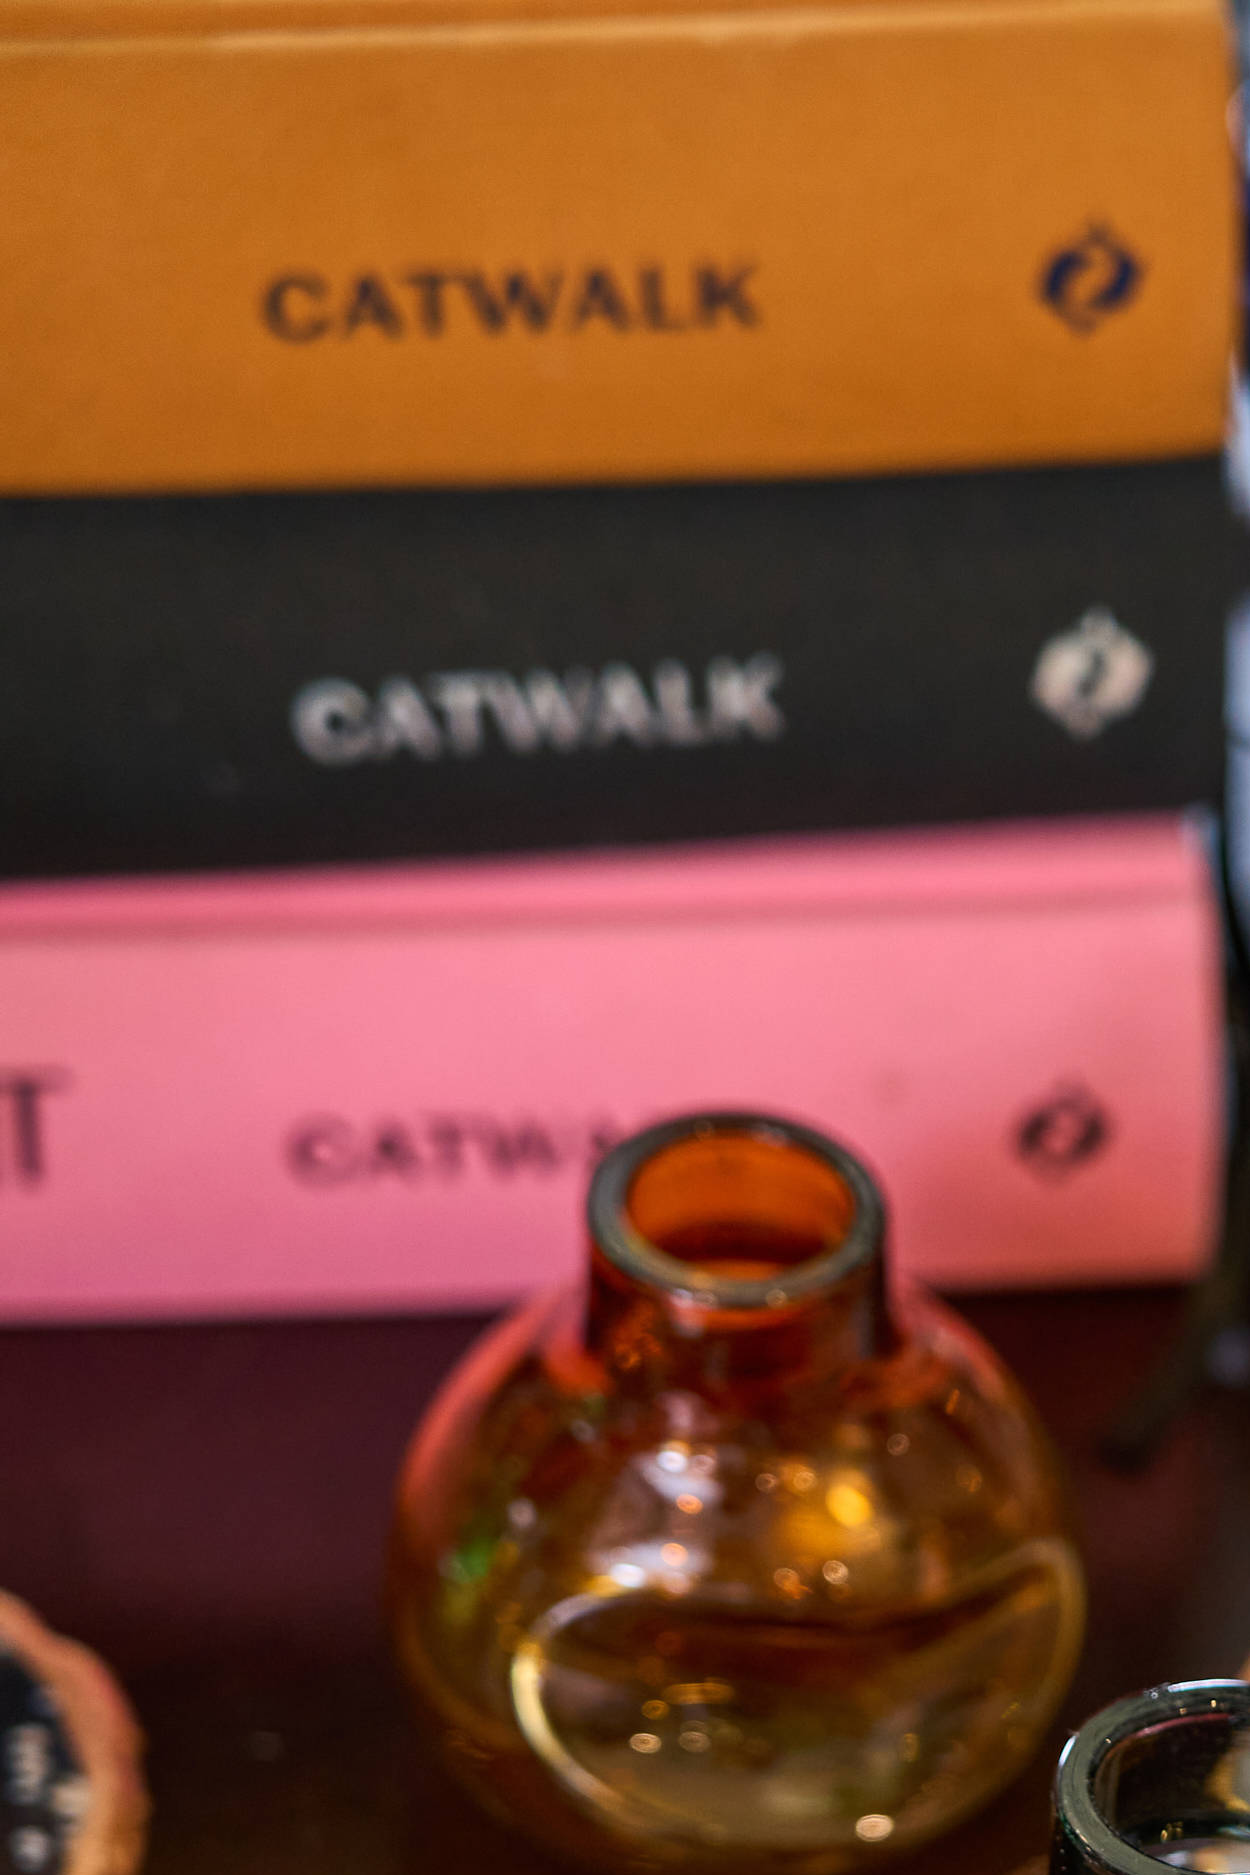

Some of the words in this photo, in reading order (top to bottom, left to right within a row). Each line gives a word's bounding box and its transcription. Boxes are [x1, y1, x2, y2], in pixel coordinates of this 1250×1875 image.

[260, 260, 762, 344] CATWALK
[291, 653, 784, 764] CATWALK
[286, 1110, 628, 1185] CATW
